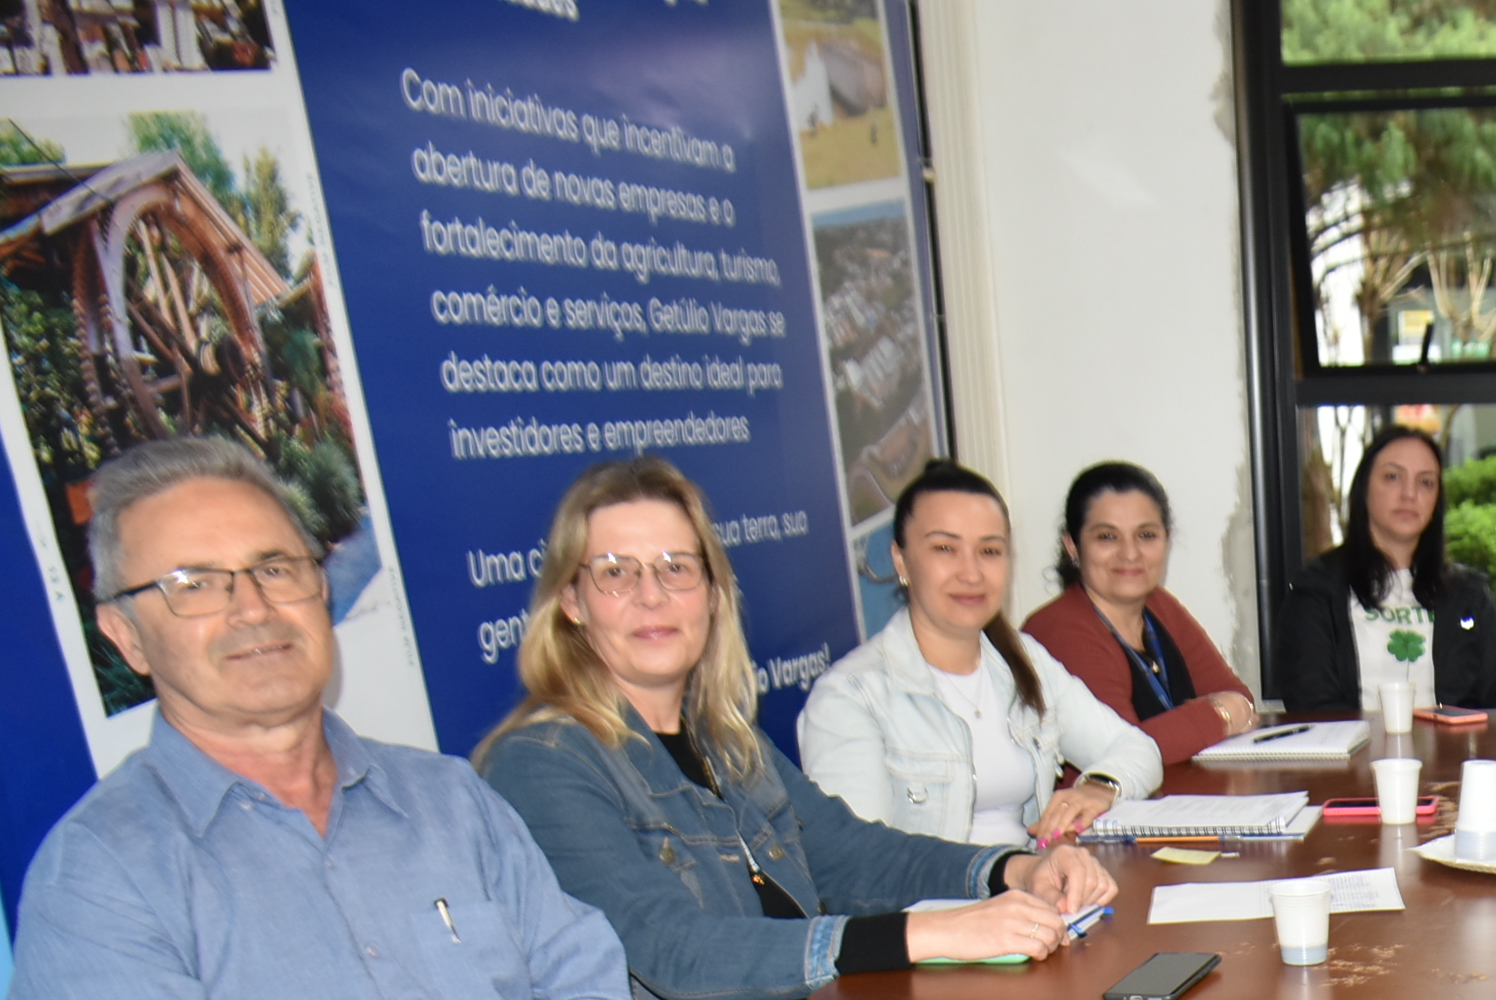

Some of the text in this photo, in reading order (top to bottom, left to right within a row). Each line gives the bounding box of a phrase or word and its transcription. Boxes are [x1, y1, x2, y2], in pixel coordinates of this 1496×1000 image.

[402, 67, 736, 173] Com iniciativas que incentivam a
[412, 139, 736, 228] abertura de novas empresas e o
[420, 208, 782, 288] fortalecimento da agricultura, turismo,
[431, 283, 787, 347] comércio e serviços, Getúlio Vargas se
[440, 350, 784, 398] destaca como um destino ideal para
[447, 409, 752, 460] investidores e empreendedores
[742, 513, 782, 544] terra,
[782, 509, 809, 537] sua
[466, 548, 527, 588] Uma
[768, 641, 831, 693] Vargas!
